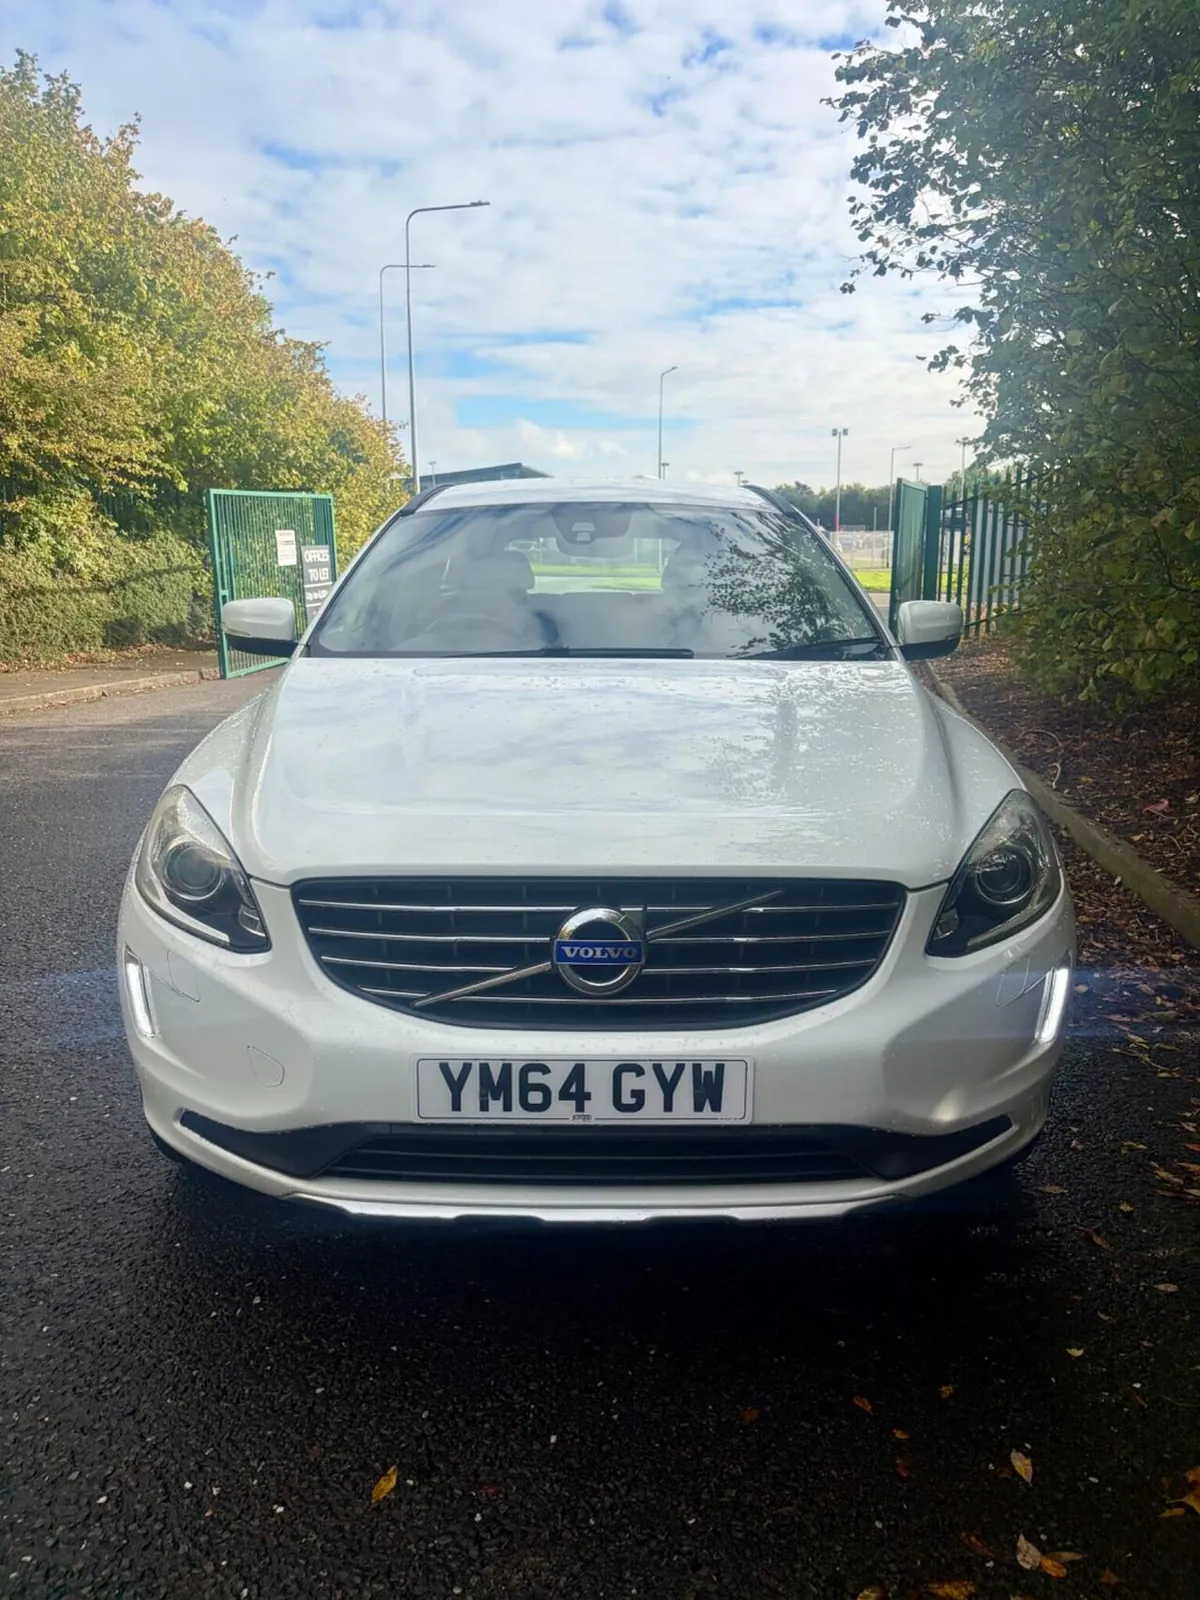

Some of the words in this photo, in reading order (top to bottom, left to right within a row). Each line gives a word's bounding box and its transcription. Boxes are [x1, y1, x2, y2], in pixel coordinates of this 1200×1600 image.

[308, 569, 319, 582] TO
[561, 946, 637, 958] VOLVO
[439, 1062, 592, 1113] YM64
[612, 1063, 725, 1113] GYW
